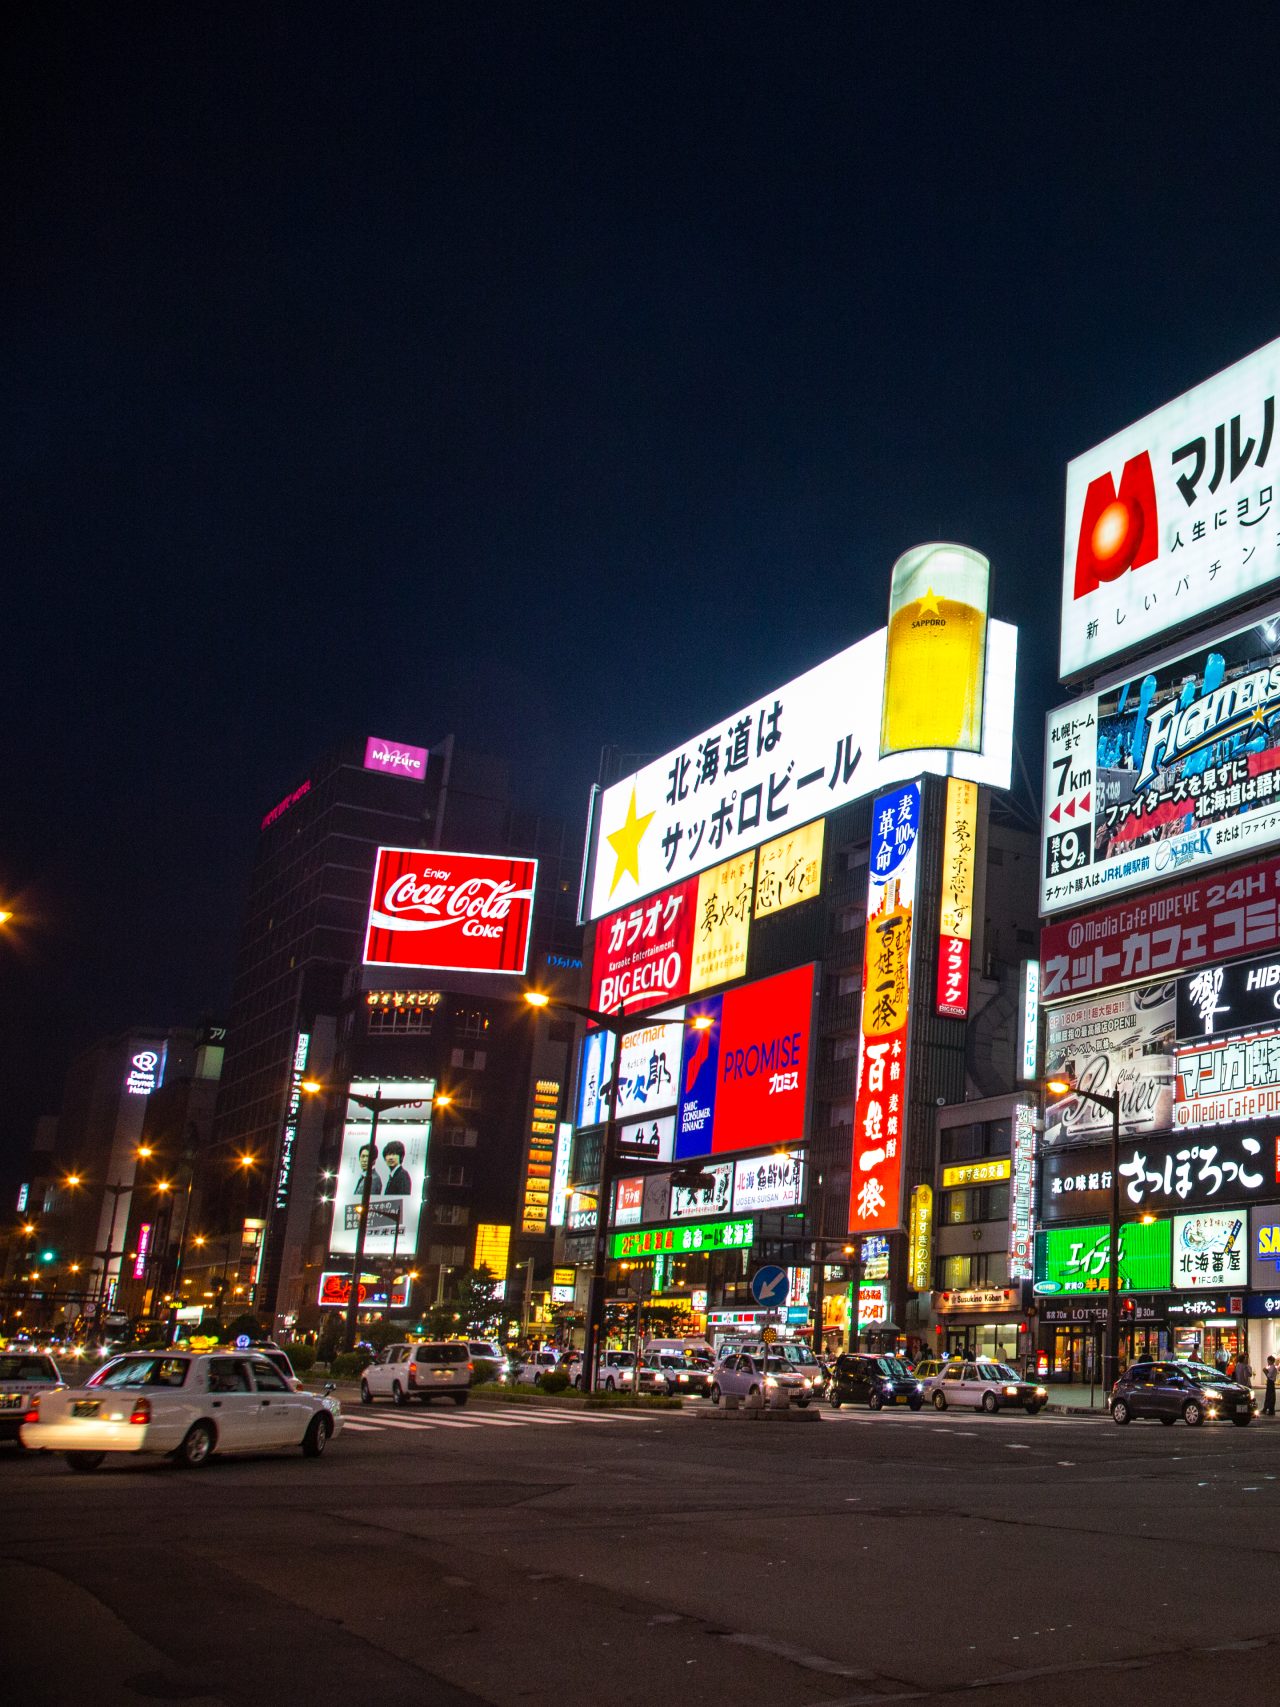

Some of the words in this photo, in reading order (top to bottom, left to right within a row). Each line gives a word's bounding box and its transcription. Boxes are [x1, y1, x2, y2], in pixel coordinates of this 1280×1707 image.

[911, 618, 946, 629] SAPPORO
[1052, 713, 1095, 743] 札幌ドーム
[1065, 735, 1080, 751] まで
[372, 750, 421, 769] Mercure
[666, 700, 784, 806] 北海道は
[1052, 755, 1091, 797] 7km
[1105, 758, 1247, 826] ファイターズを見ずに
[661, 734, 862, 873] サッポロビール
[876, 808, 896, 872] 革命
[894, 794, 916, 856] 麦100%の
[1216, 828, 1239, 845] または
[1051, 837, 1060, 873] 地下鉄
[1060, 831, 1086, 870] 9分
[424, 868, 451, 880] Enjoy
[1046, 873, 1100, 901] チケット購入は
[1101, 855, 1150, 883] JR札幌駅前
[384, 872, 516, 920] Coca-Cola
[1085, 914, 1117, 941] Media
[1119, 907, 1147, 932] Cafe
[1149, 891, 1200, 924] POPEYE
[1206, 872, 1266, 907] 24H
[462, 918, 503, 938] Coke
[607, 894, 683, 955] カラオケ
[609, 957, 631, 971] Karaoke
[632, 939, 675, 963] Entertainment
[873, 916, 904, 1031] 百姓一揆
[945, 938, 964, 1003] カラオケ
[1042, 921, 1207, 996] ネットカフェ
[599, 976, 630, 1014] BIG
[632, 952, 681, 992] ECHO
[724, 1032, 801, 1083] PROMISE
[889, 1039, 902, 1081] 本格
[769, 1071, 799, 1095] プロミス
[683, 1100, 698, 1111] SMBC
[683, 1107, 711, 1123] CONSUMER
[1191, 1094, 1225, 1124] Media
[1227, 1092, 1256, 1117] Cafe
[682, 1121, 704, 1133] FINANCE
[857, 1042, 890, 1220] 百姓一揆
[885, 1093, 899, 1159] 麦焼酎
[958, 1164, 1005, 1181] すすきの交番
[1051, 1171, 1113, 1194] 北の味紀行
[1119, 1138, 1264, 1204] さっぽろっこ
[783, 1190, 794, 1200] 入口
[917, 1208, 929, 1287] すすきの交番
[1180, 1250, 1241, 1273] 北海番屋
[957, 1295, 982, 1303] Susukino
